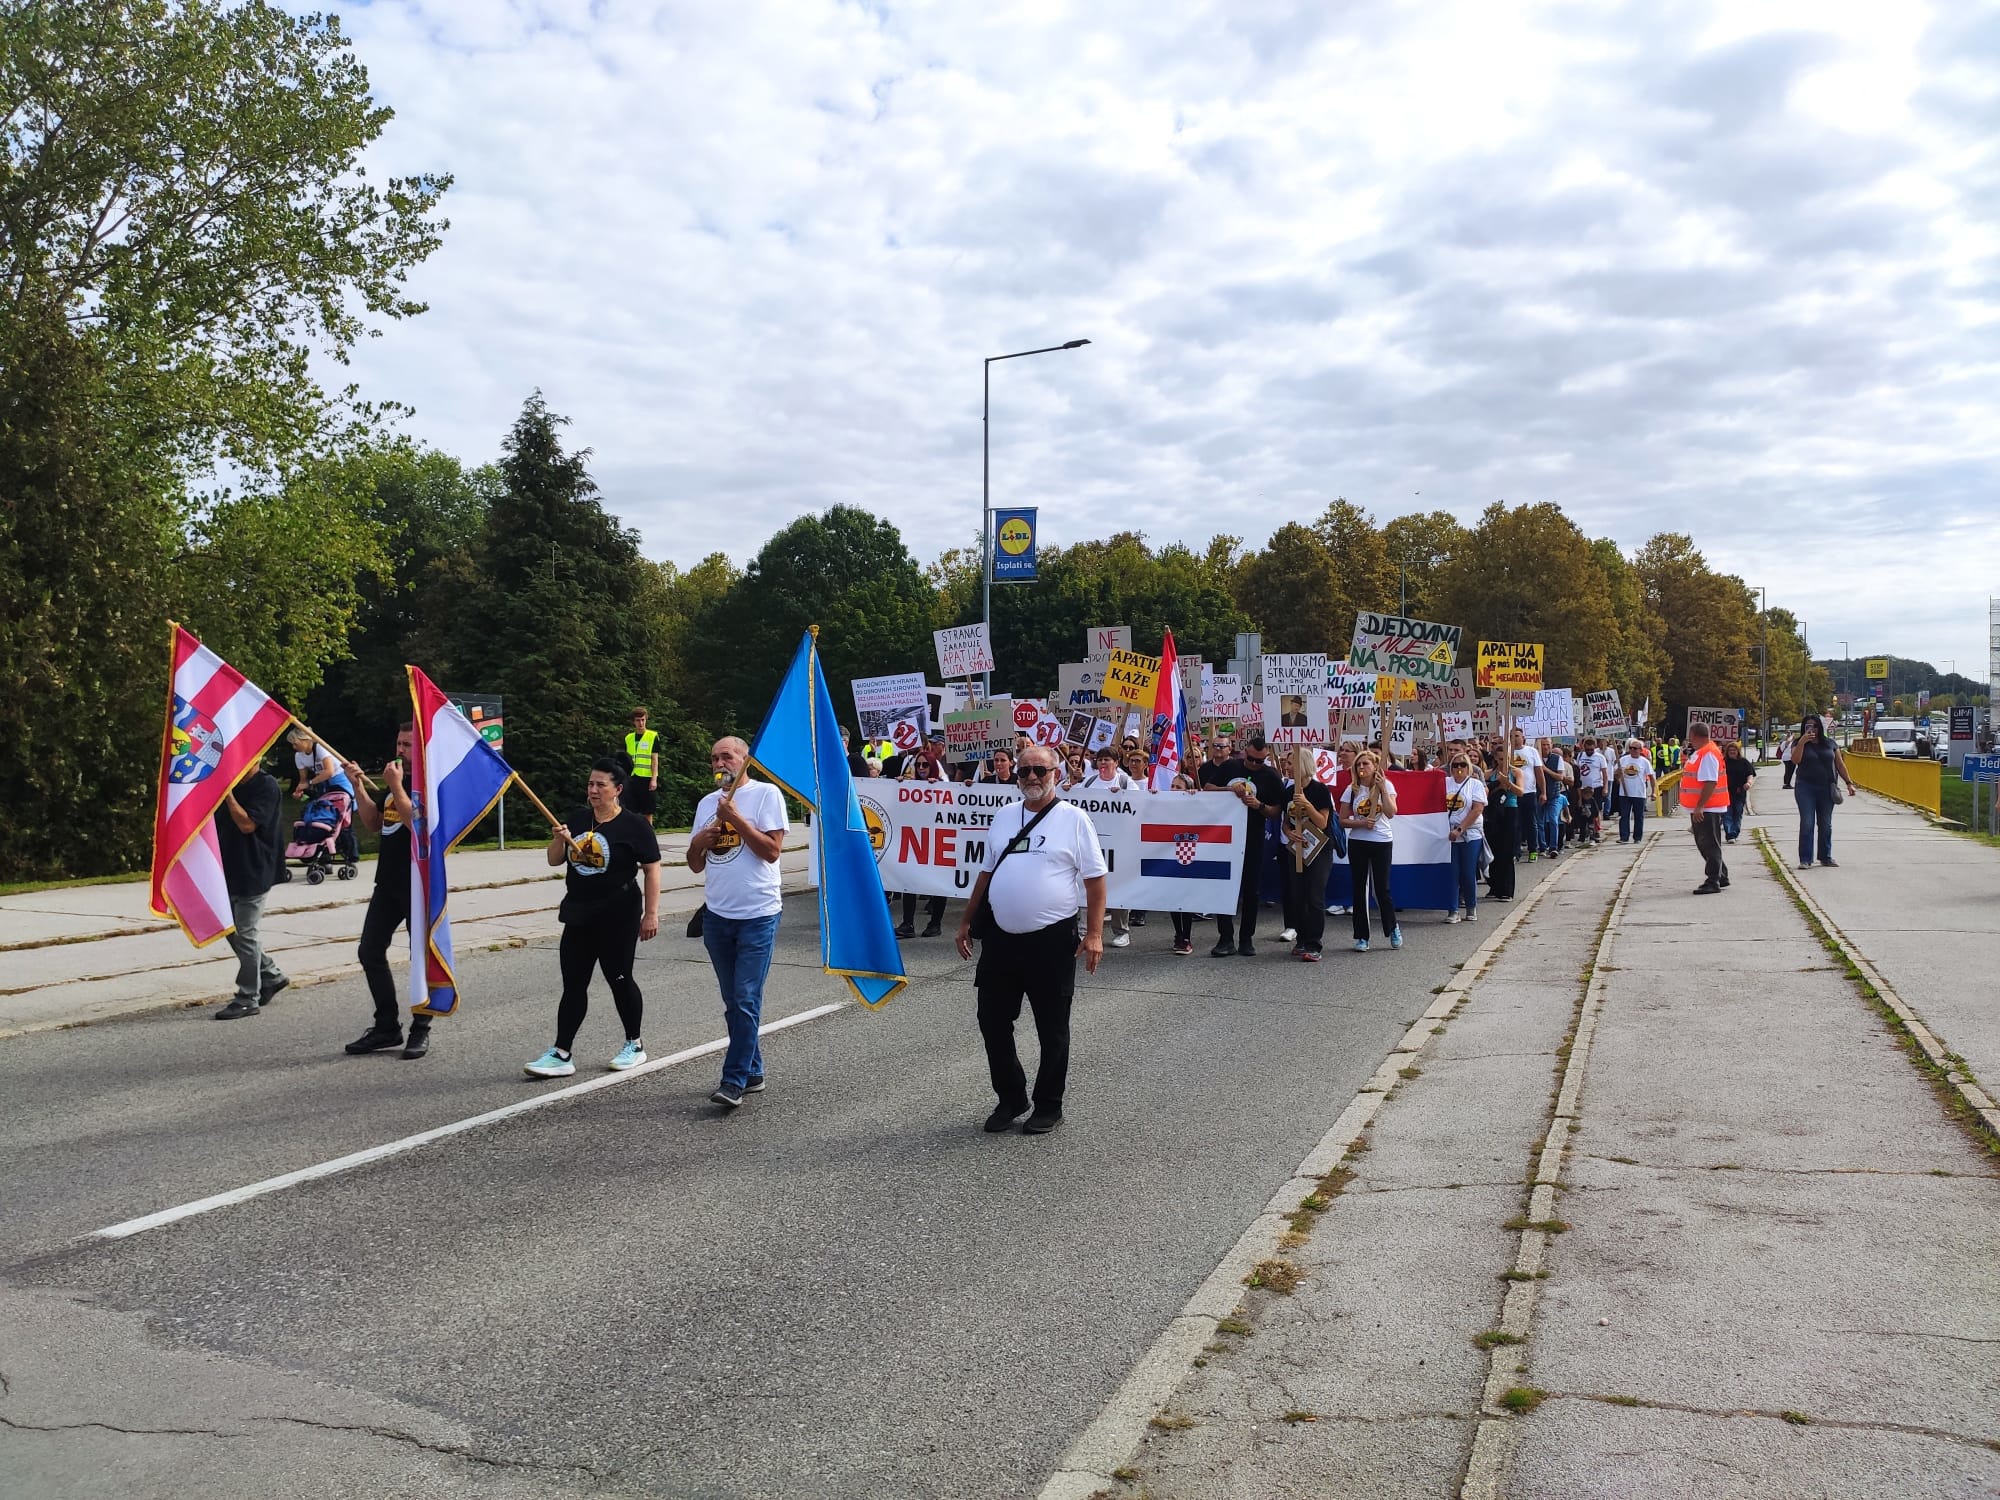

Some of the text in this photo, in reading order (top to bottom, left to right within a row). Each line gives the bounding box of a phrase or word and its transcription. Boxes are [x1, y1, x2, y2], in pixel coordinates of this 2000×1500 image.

[996, 561, 1023, 571] Isplati
[941, 626, 983, 643] STRANAC
[1377, 635, 1437, 656] NIJE
[1481, 642, 1536, 659] APATIJA
[942, 647, 985, 666] APATIJA
[1290, 655, 1326, 667] NISMO
[1350, 645, 1380, 671] NA
[1513, 657, 1539, 672] DOM
[942, 658, 994, 676] GUTA SMRAD
[1110, 667, 1151, 688] KAŽE
[1477, 665, 1496, 687] NE
[1119, 685, 1140, 700] NE
[1341, 681, 1377, 696] SISAK
[1016, 711, 1037, 721] STOP
[1213, 703, 1240, 716] PROFIT
[1689, 710, 1723, 725] FARME
[946, 719, 991, 733] KUPUJETE
[1550, 720, 1569, 736] HR
[1711, 724, 1738, 740] BOLE
[946, 730, 988, 744] TRUJETE
[1272, 728, 1325, 743] AM NAJ
[948, 737, 1014, 753] PRLJAVI PROFIT
[898, 788, 954, 805] DOSTA
[935, 811, 944, 824] A
[947, 812, 967, 825] NA
[898, 826, 958, 868] NE
